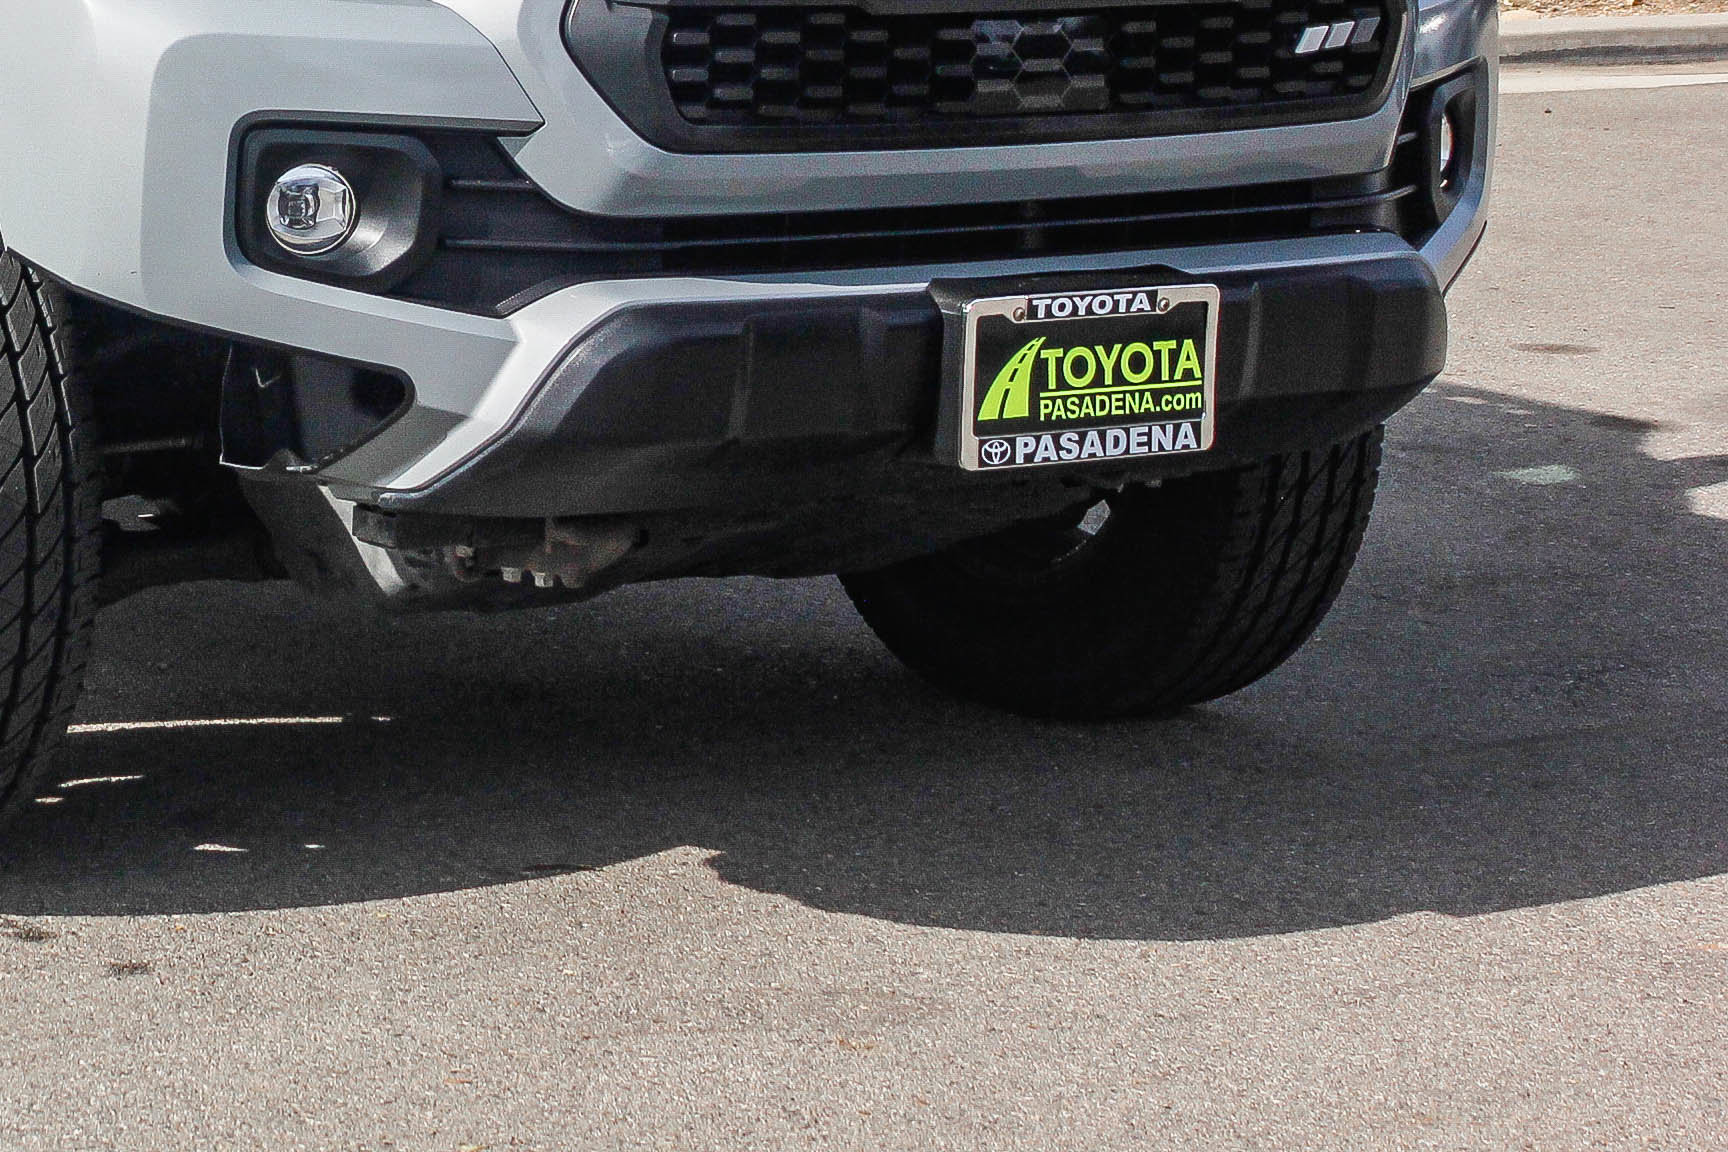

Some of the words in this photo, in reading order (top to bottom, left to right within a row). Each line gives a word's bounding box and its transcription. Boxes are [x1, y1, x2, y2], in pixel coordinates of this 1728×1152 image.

[1032, 292, 1151, 319] TOYOTA
[1040, 339, 1202, 390] TOYOTA
[1040, 391, 1202, 421] PASADENA.com
[1015, 422, 1198, 464] PASADENA
